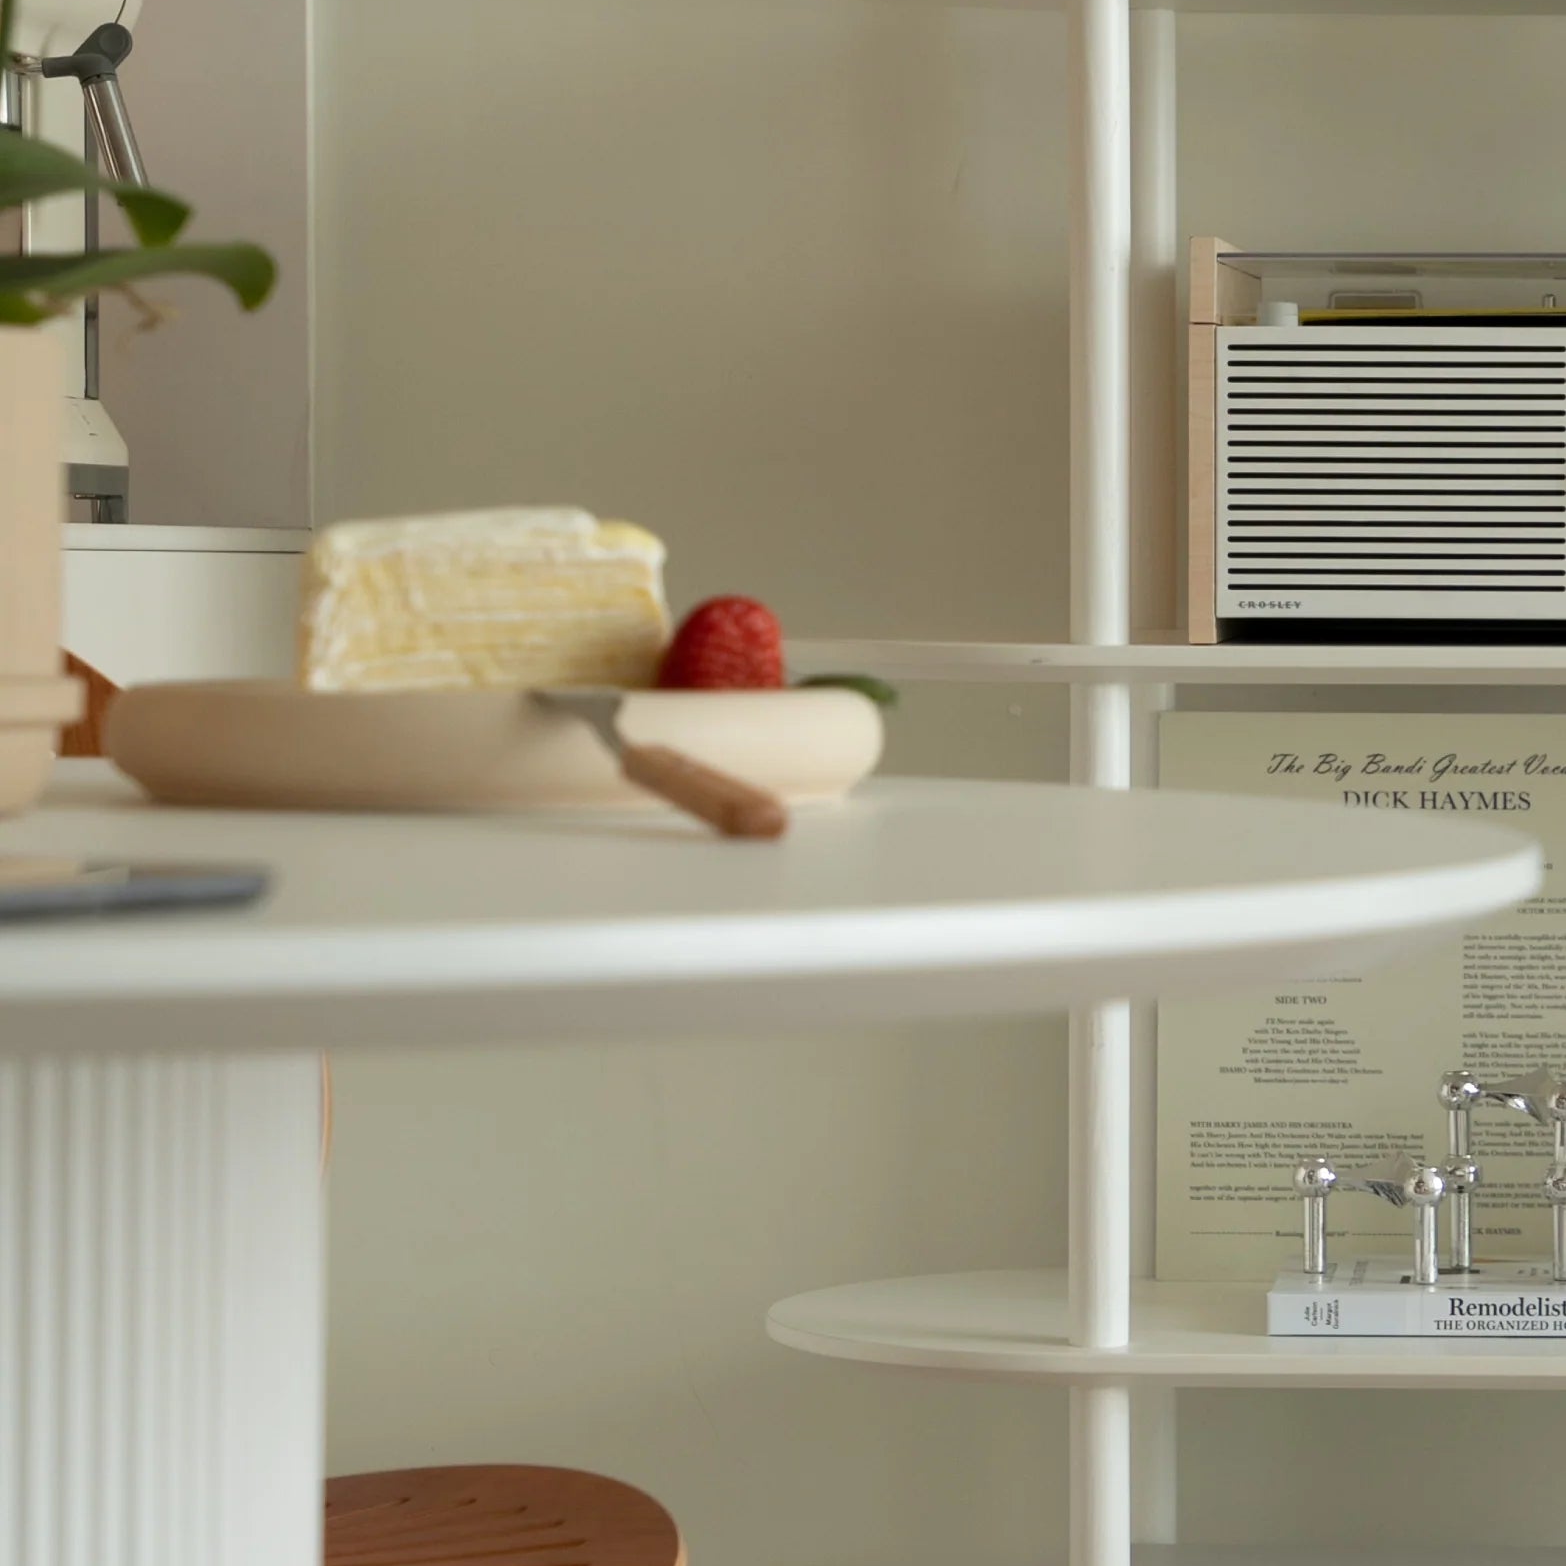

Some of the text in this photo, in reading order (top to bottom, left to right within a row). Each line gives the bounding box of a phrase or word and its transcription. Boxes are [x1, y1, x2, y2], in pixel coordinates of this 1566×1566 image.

[1266, 753, 1305, 775] The
[1313, 753, 1352, 782] Big
[1429, 753, 1518, 782] Greatest
[1419, 790, 1532, 811] HAYMES
[1274, 995, 1327, 1004] SIDE TWO
[1433, 1320, 1464, 1331] THE
[1466, 1320, 1549, 1331] ORGANIZED
